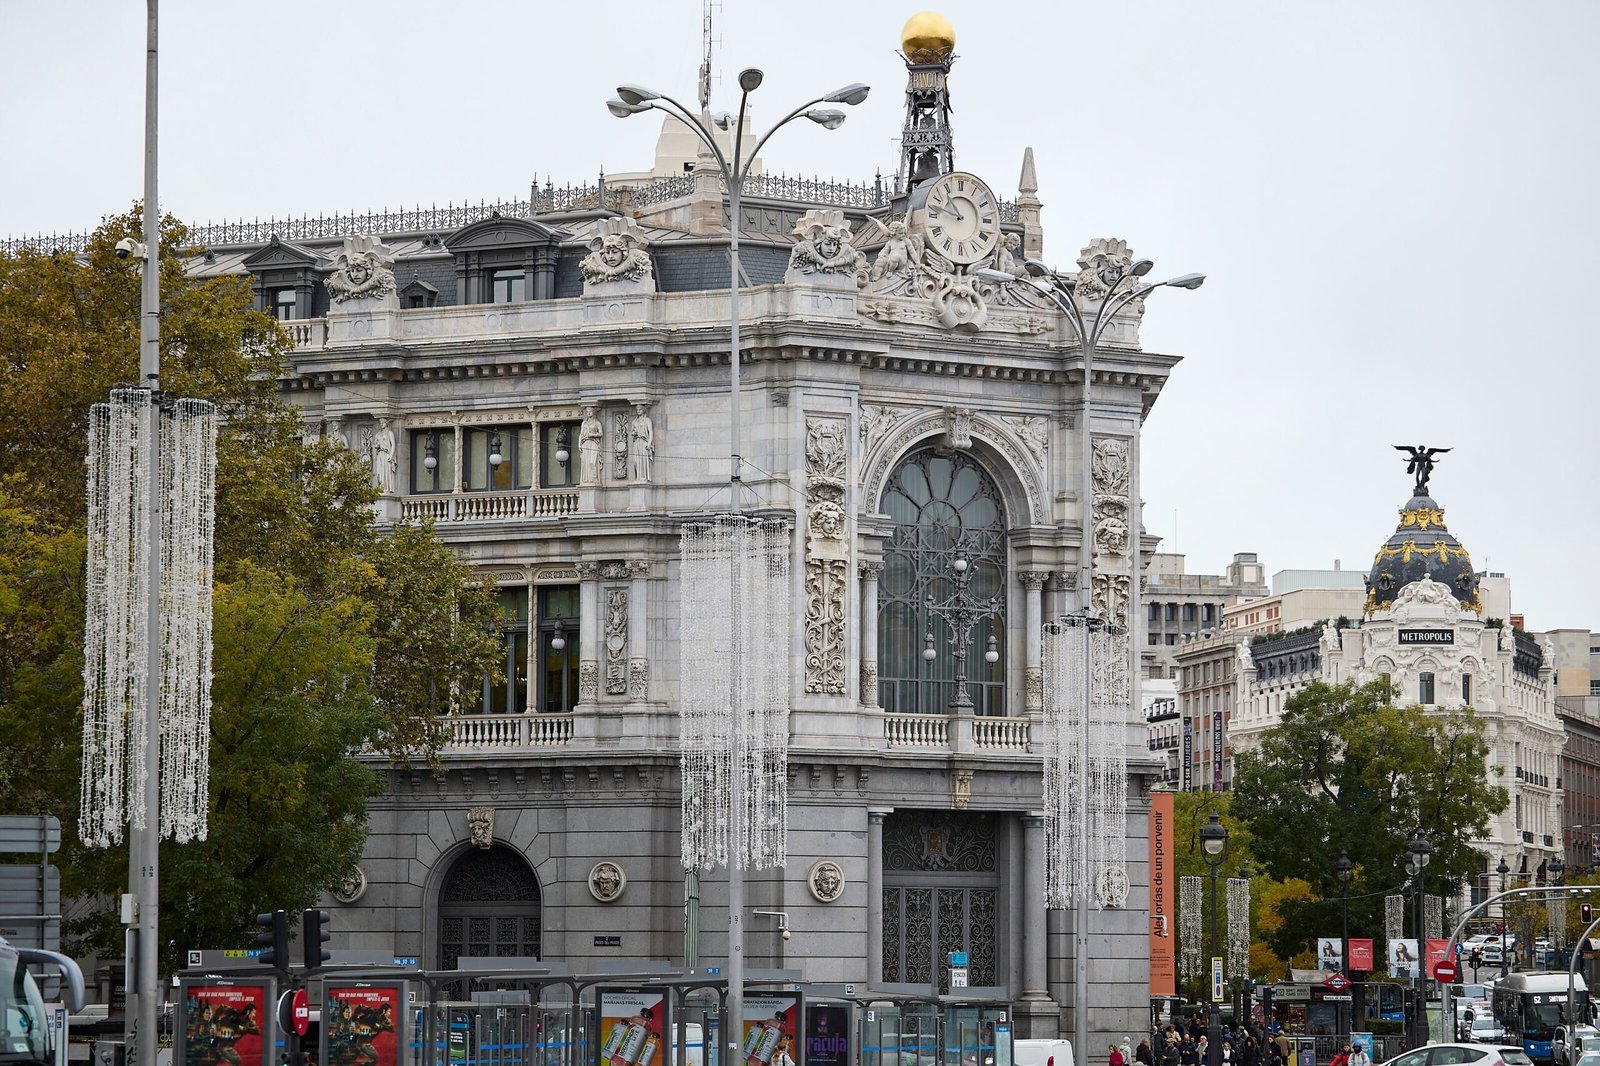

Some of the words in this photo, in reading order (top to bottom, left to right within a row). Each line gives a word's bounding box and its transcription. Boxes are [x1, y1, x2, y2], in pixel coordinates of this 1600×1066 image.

[1401, 632, 1452, 640] METROPOLIS
[1153, 811, 1164, 856] porvenir
[1156, 858, 1163, 871] un
[1153, 871, 1163, 886] de
[1534, 996, 1541, 1004] 52
